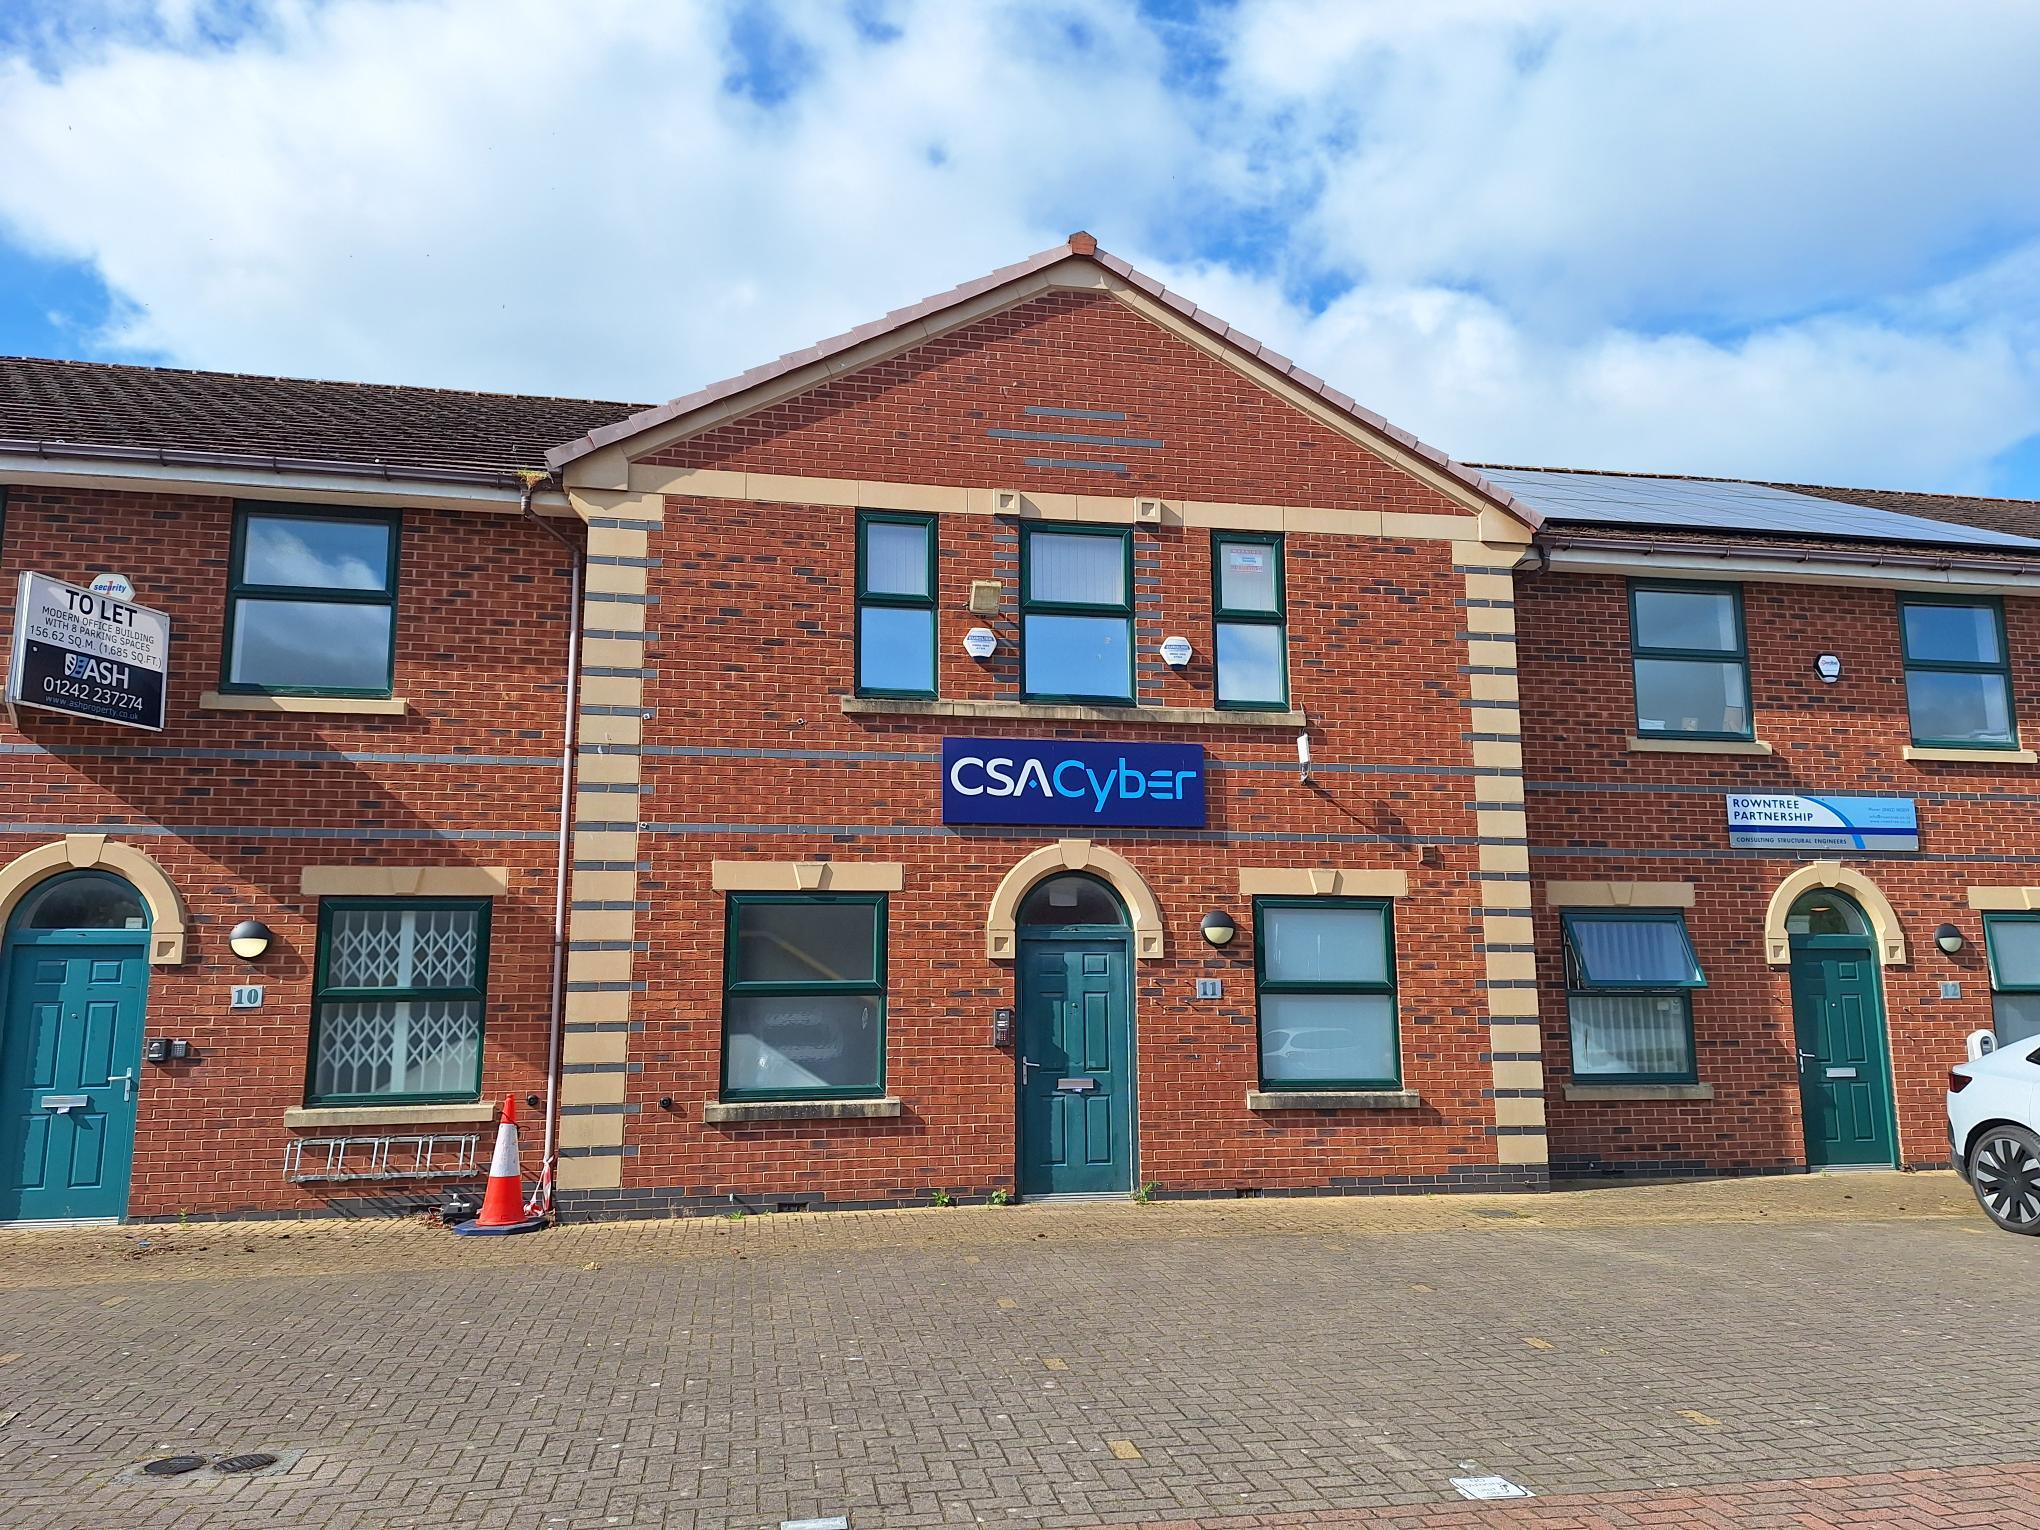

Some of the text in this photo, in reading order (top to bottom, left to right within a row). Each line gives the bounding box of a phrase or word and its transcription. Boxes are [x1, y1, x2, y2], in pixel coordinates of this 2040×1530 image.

[94, 583, 127, 593] security
[65, 589, 138, 627] TO LET
[30, 624, 65, 642] 156.62
[68, 634, 96, 651] SQ.M.
[42, 606, 154, 644] MODERN OFFICE BUILDING
[45, 617, 151, 653] WITH 8 PARKING SPACES
[82, 658, 129, 690] ASH
[43, 676, 143, 711] 01242 237274
[45, 694, 139, 721] www.ashproperty.co.uk
[1732, 798, 1800, 809] ROWNTREE
[1734, 811, 1814, 822] PARTNERSHIP
[234, 988, 259, 1005] 10
[1200, 981, 1217, 996] 11
[1942, 984, 1959, 997] 12
